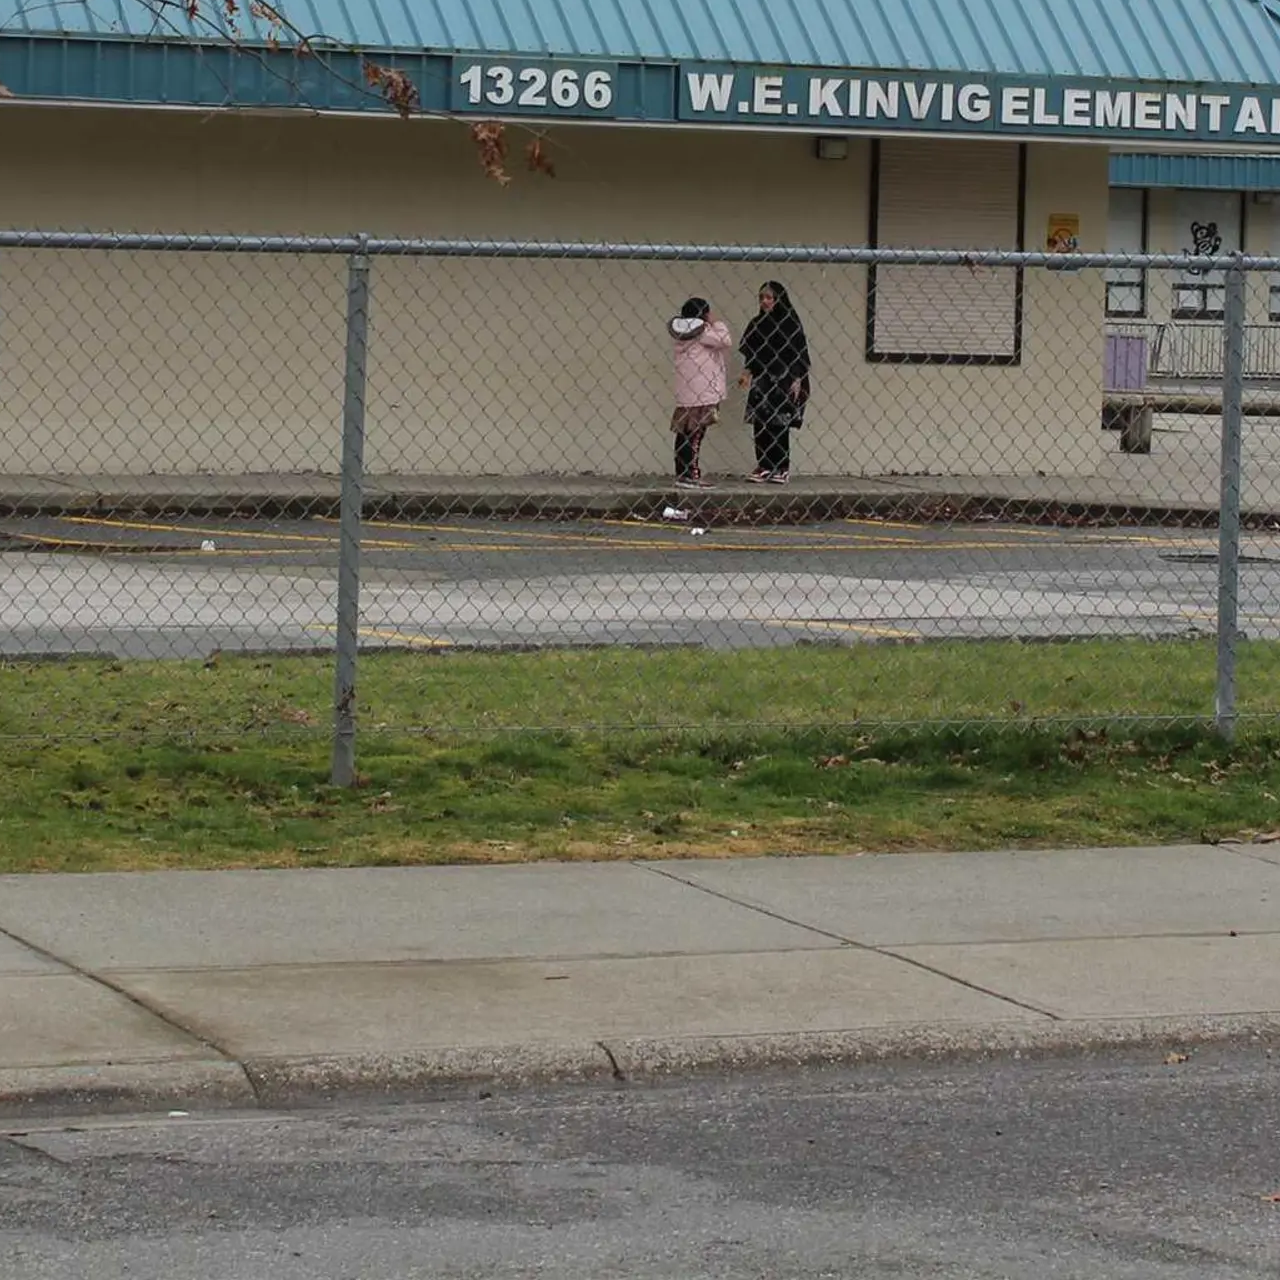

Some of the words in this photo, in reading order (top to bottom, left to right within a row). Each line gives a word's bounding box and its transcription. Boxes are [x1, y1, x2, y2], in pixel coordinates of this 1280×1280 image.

[460, 64, 613, 110] 13266
[687, 72, 798, 116] W.E.
[808, 77, 991, 123] KINVIG
